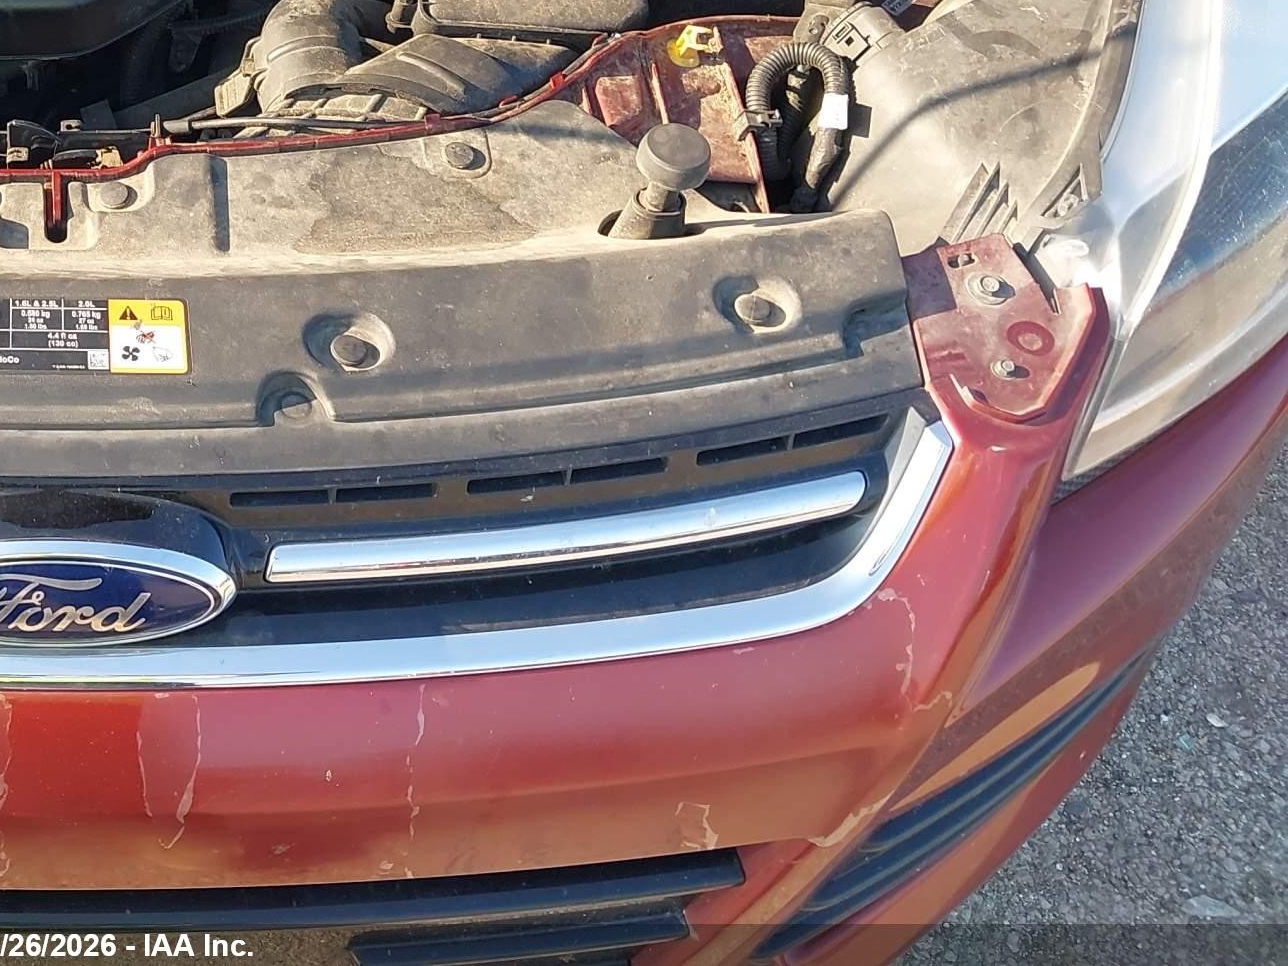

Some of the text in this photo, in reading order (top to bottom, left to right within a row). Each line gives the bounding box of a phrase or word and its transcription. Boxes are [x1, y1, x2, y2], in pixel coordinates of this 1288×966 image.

[41, 310, 51, 318] kg
[92, 311, 101, 319] kg
[47, 332, 59, 340] 4.4
